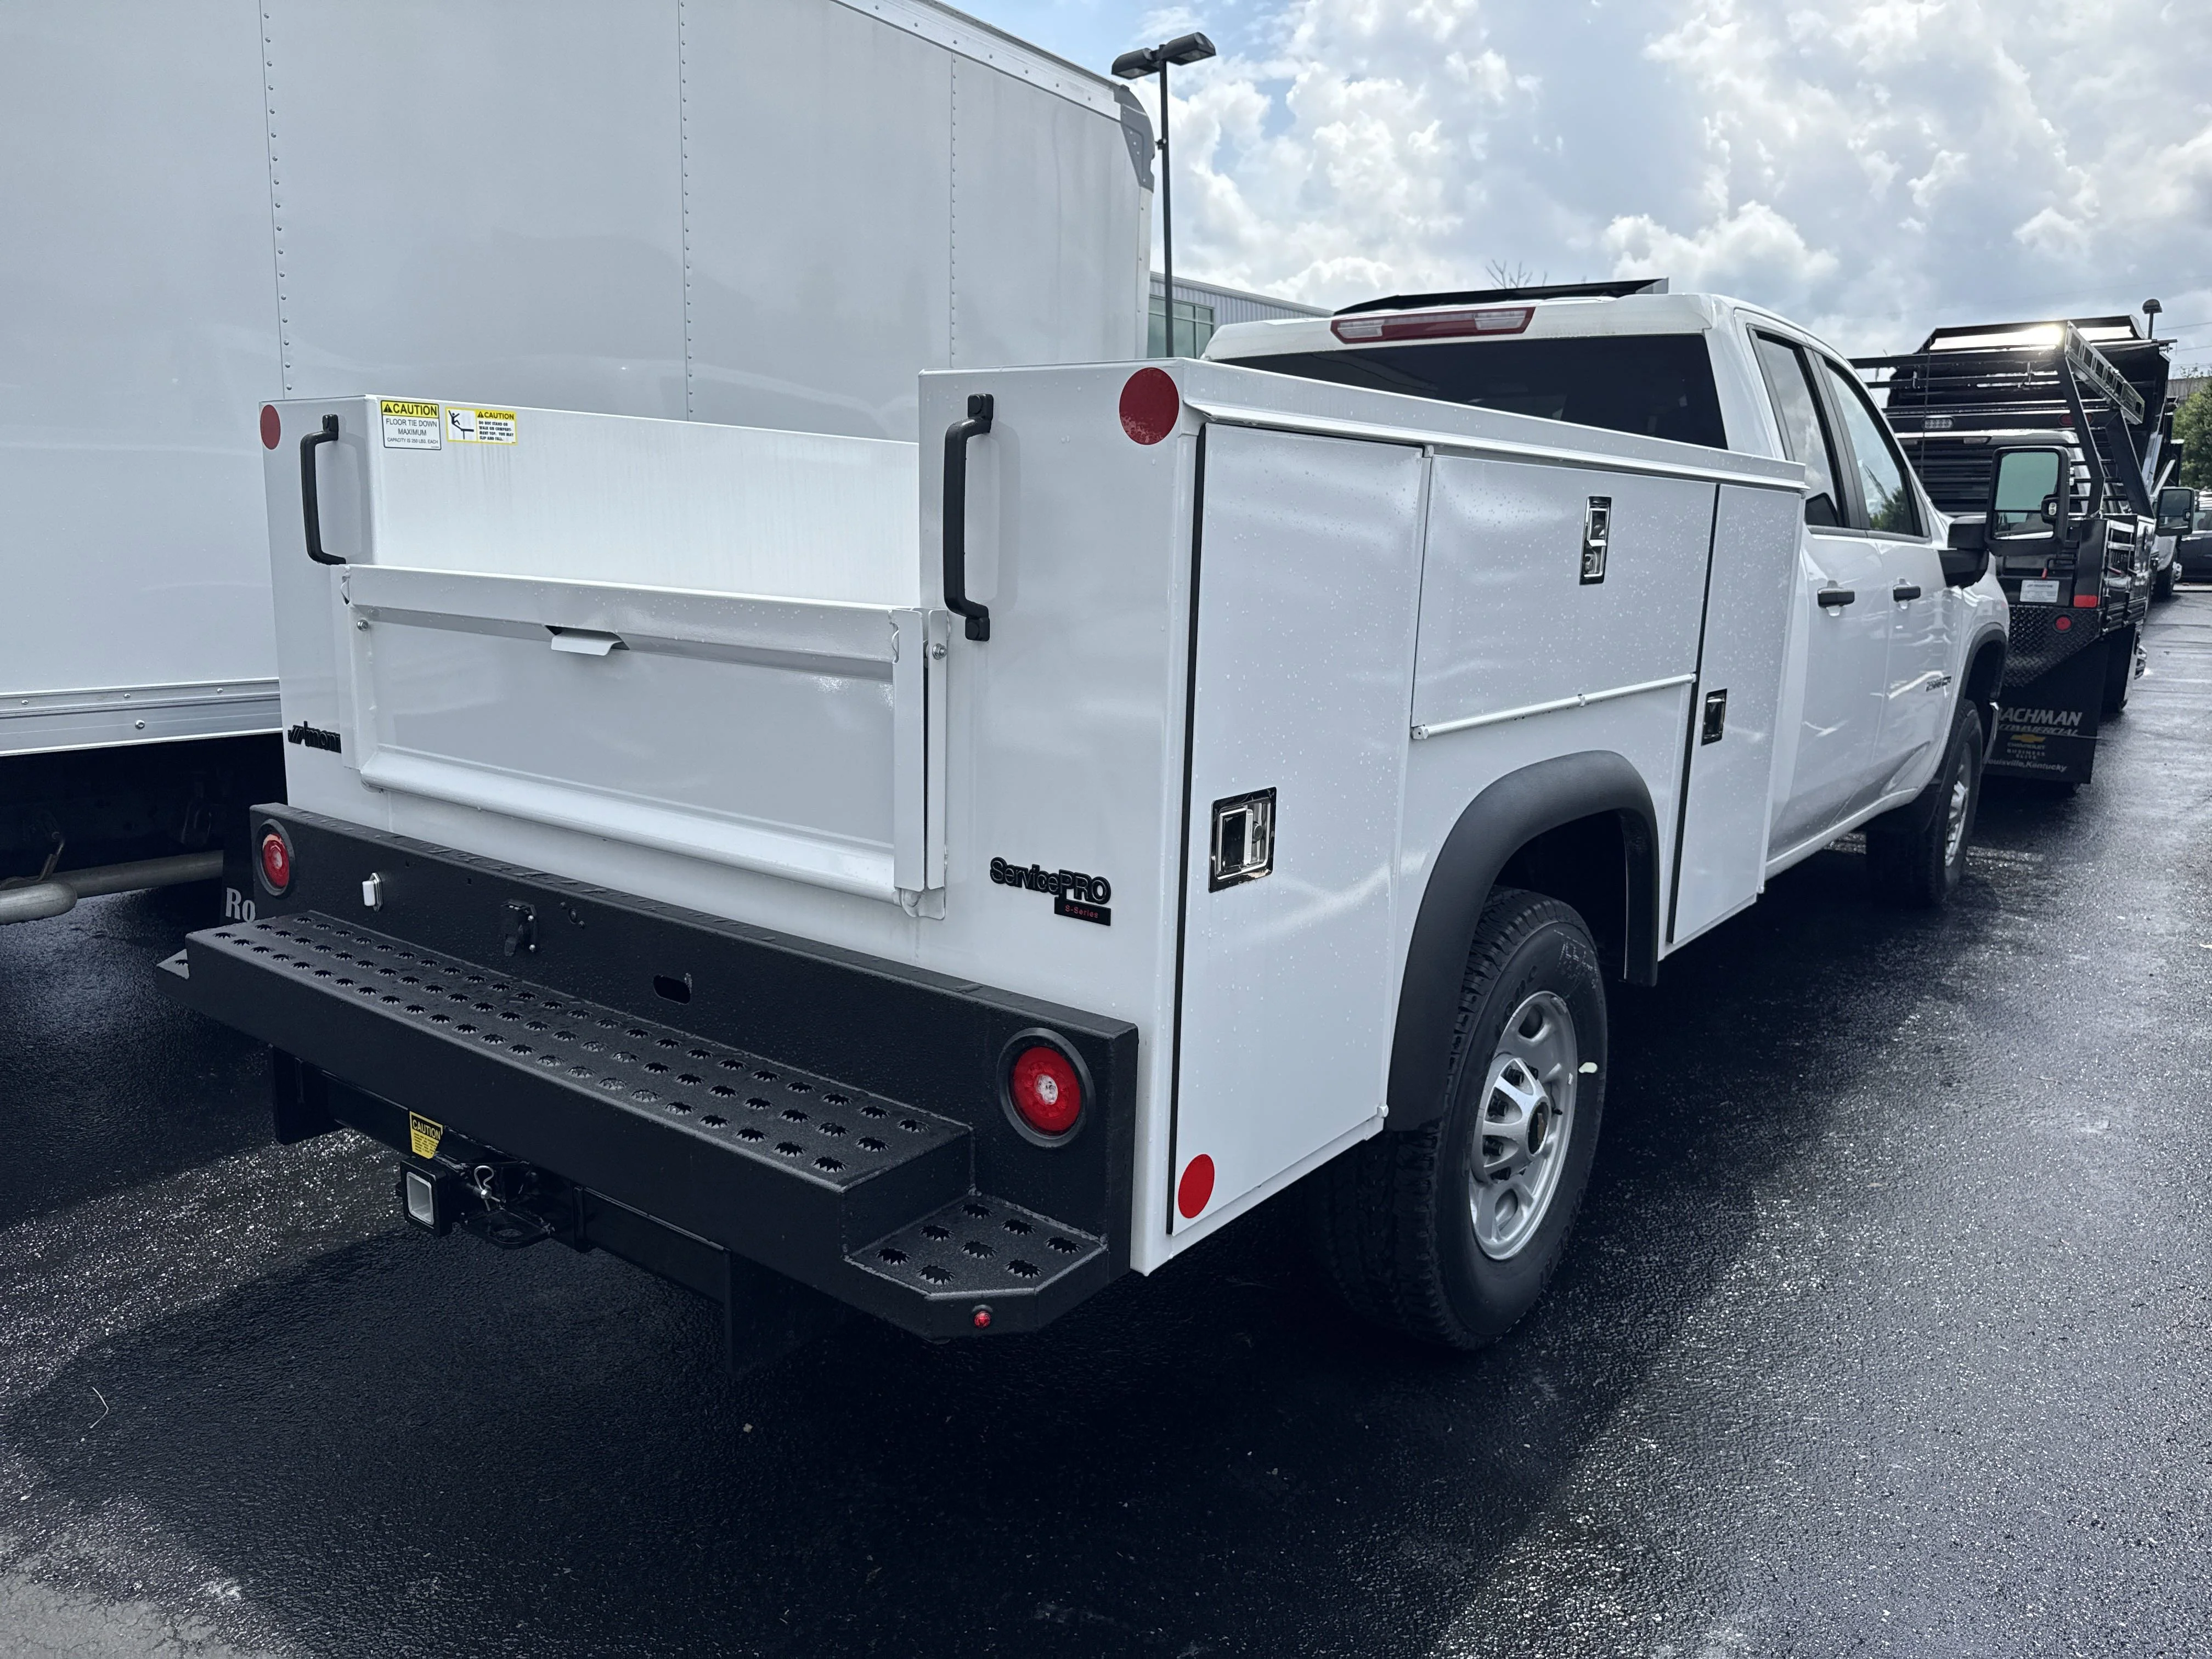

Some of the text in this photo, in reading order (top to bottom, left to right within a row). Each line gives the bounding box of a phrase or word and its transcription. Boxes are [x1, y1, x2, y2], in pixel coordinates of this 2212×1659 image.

[393, 403, 437, 416] CAUTION
[484, 411, 514, 420] CAUTION
[398, 428, 427, 436] MAXIMUM
[990, 857, 1111, 904] ServicePRO
[1064, 905, 1099, 918] S-Series
[413, 1119, 441, 1141] CAUTION
